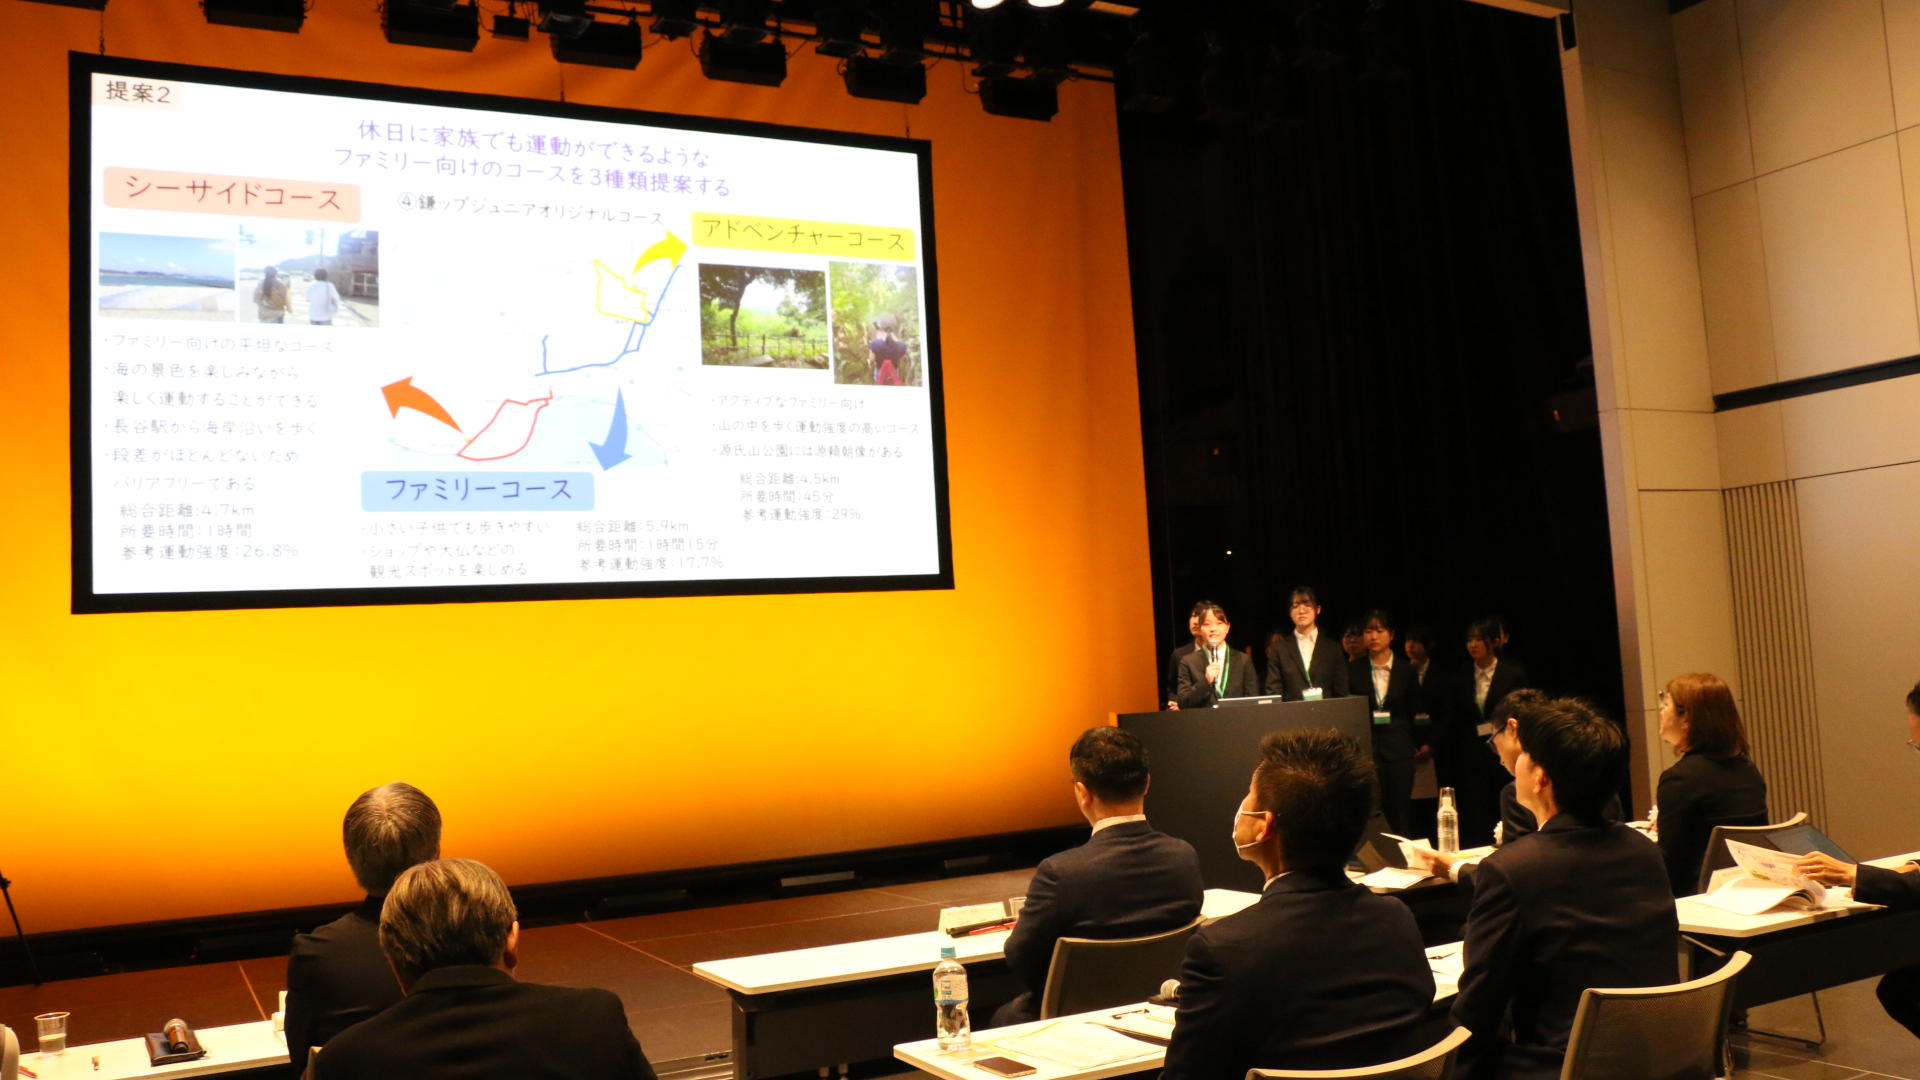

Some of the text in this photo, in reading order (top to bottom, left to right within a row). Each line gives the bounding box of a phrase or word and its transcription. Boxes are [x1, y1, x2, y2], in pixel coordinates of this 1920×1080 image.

[106, 79, 171, 105] 提案2
[358, 119, 710, 168] 休日に家族でも運動ができるような
[335, 148, 732, 197] ファミリー向けのコースを3種類提案する
[126, 174, 342, 211] シーサイドコース
[702, 218, 905, 250] アドベンチャーコース
[385, 477, 573, 501] ファミリーコース
